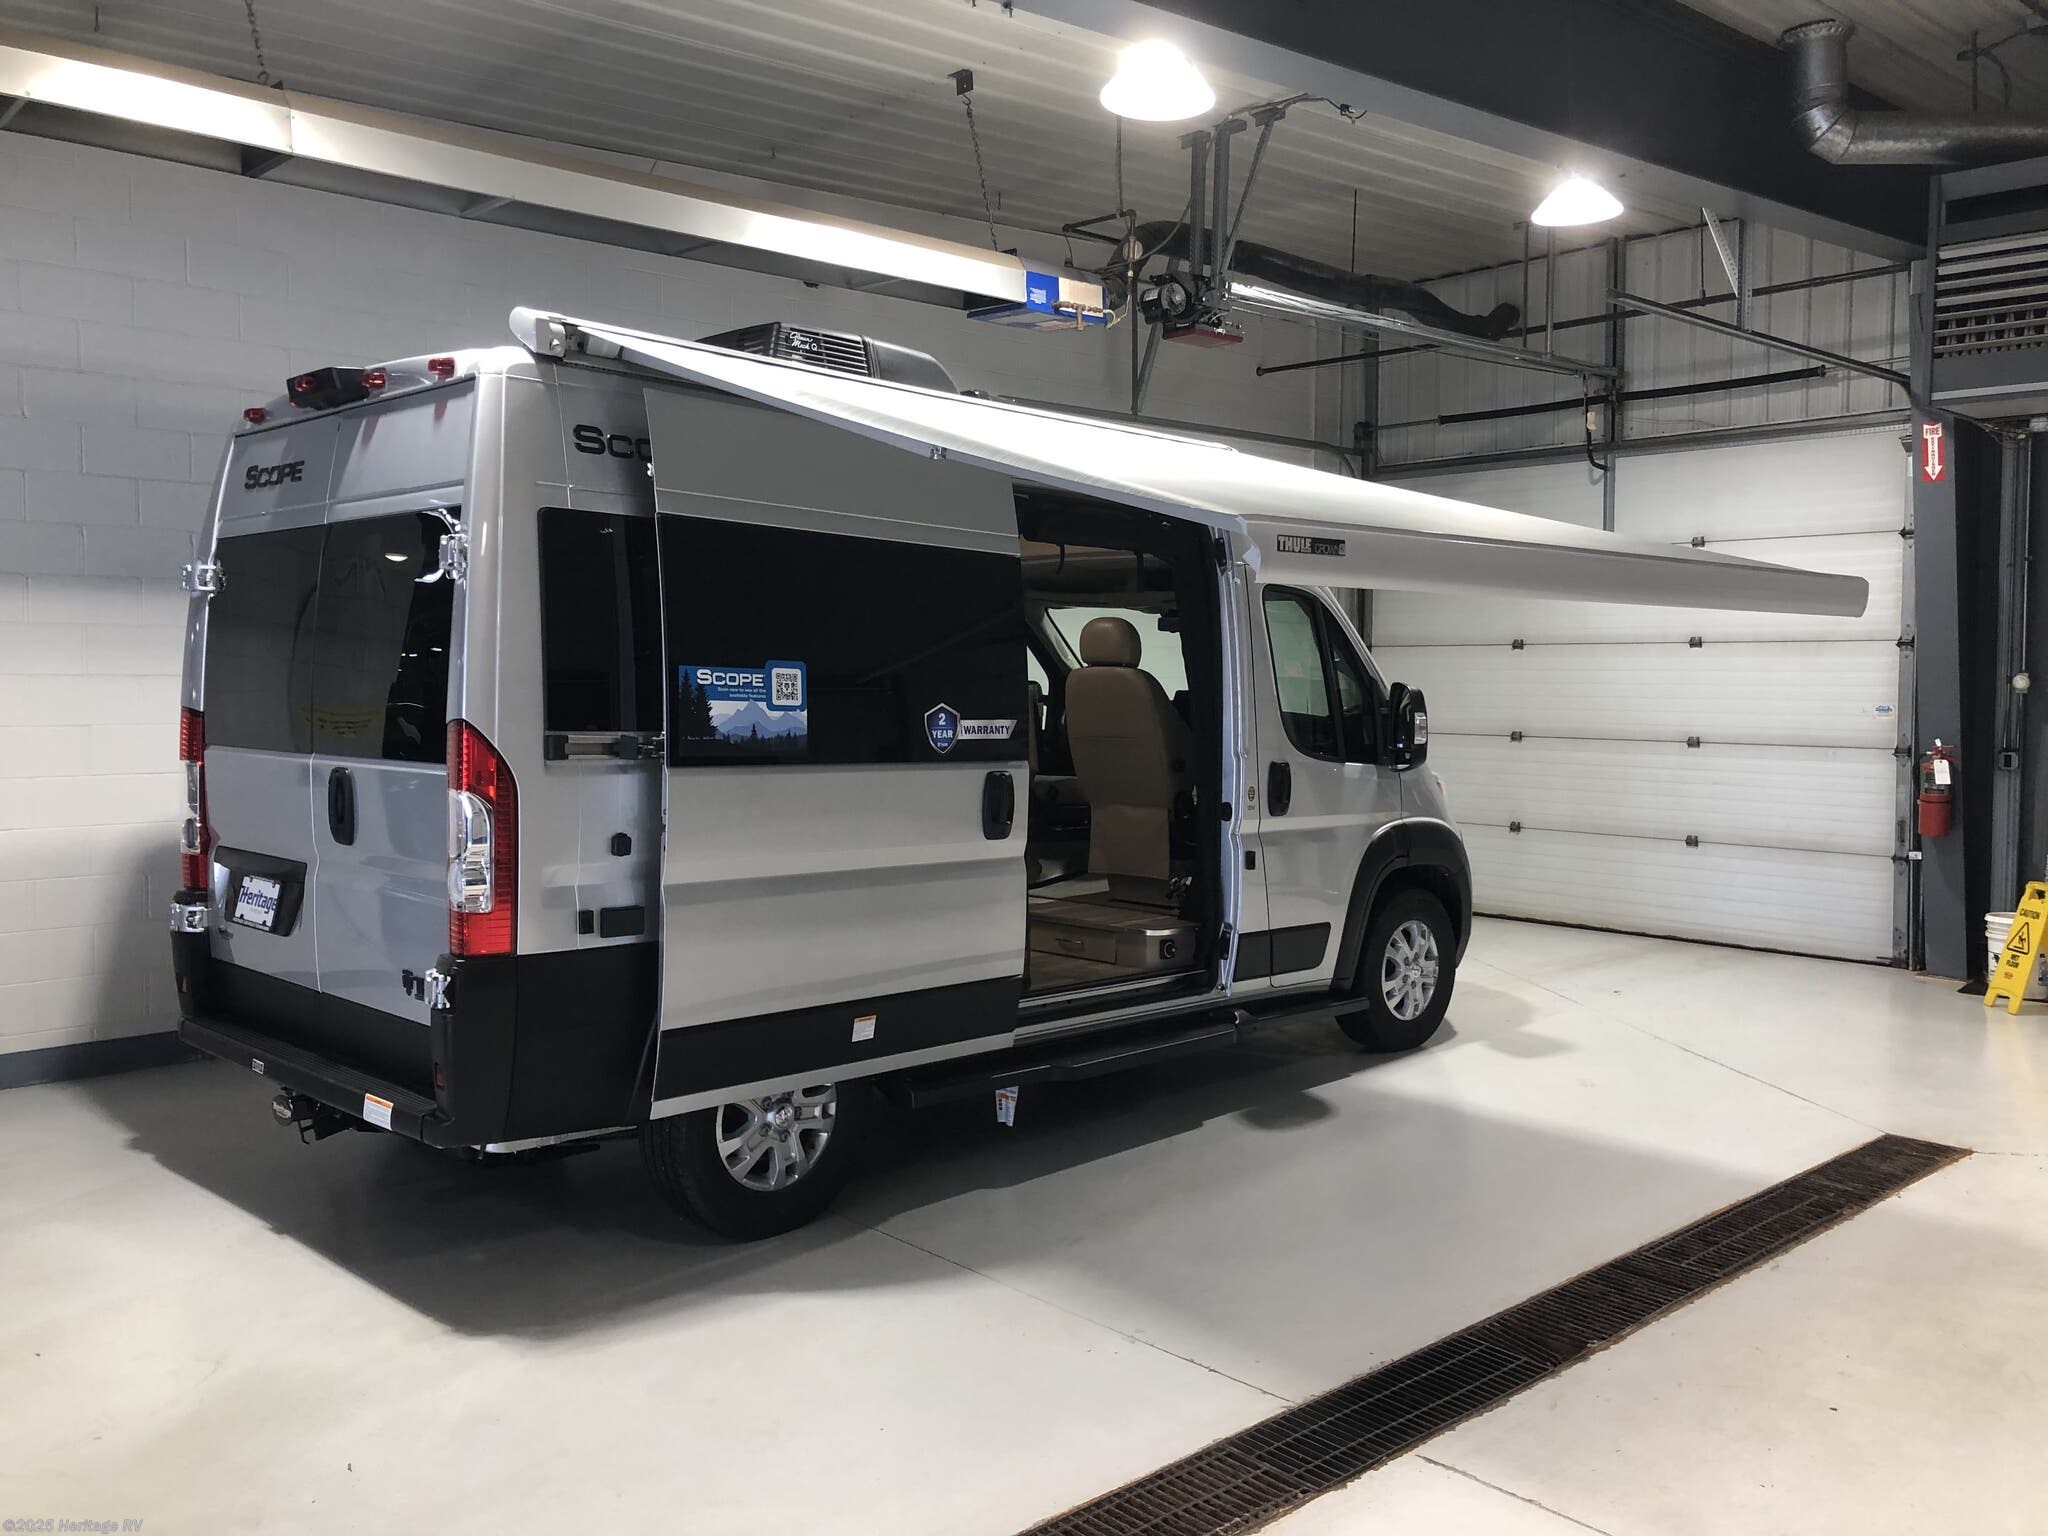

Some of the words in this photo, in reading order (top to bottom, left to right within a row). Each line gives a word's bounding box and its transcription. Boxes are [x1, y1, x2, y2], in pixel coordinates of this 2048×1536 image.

[1925, 427, 1940, 436] FIRE
[244, 460, 305, 489] SCOPE
[1278, 536, 1312, 553] THULE
[696, 668, 765, 686] SCOPE
[938, 713, 946, 725] 2
[932, 730, 953, 739] YEAR
[963, 725, 1010, 735] WARRANTY
[240, 886, 278, 914] Heritage
[2019, 908, 2041, 920] CAUTION
